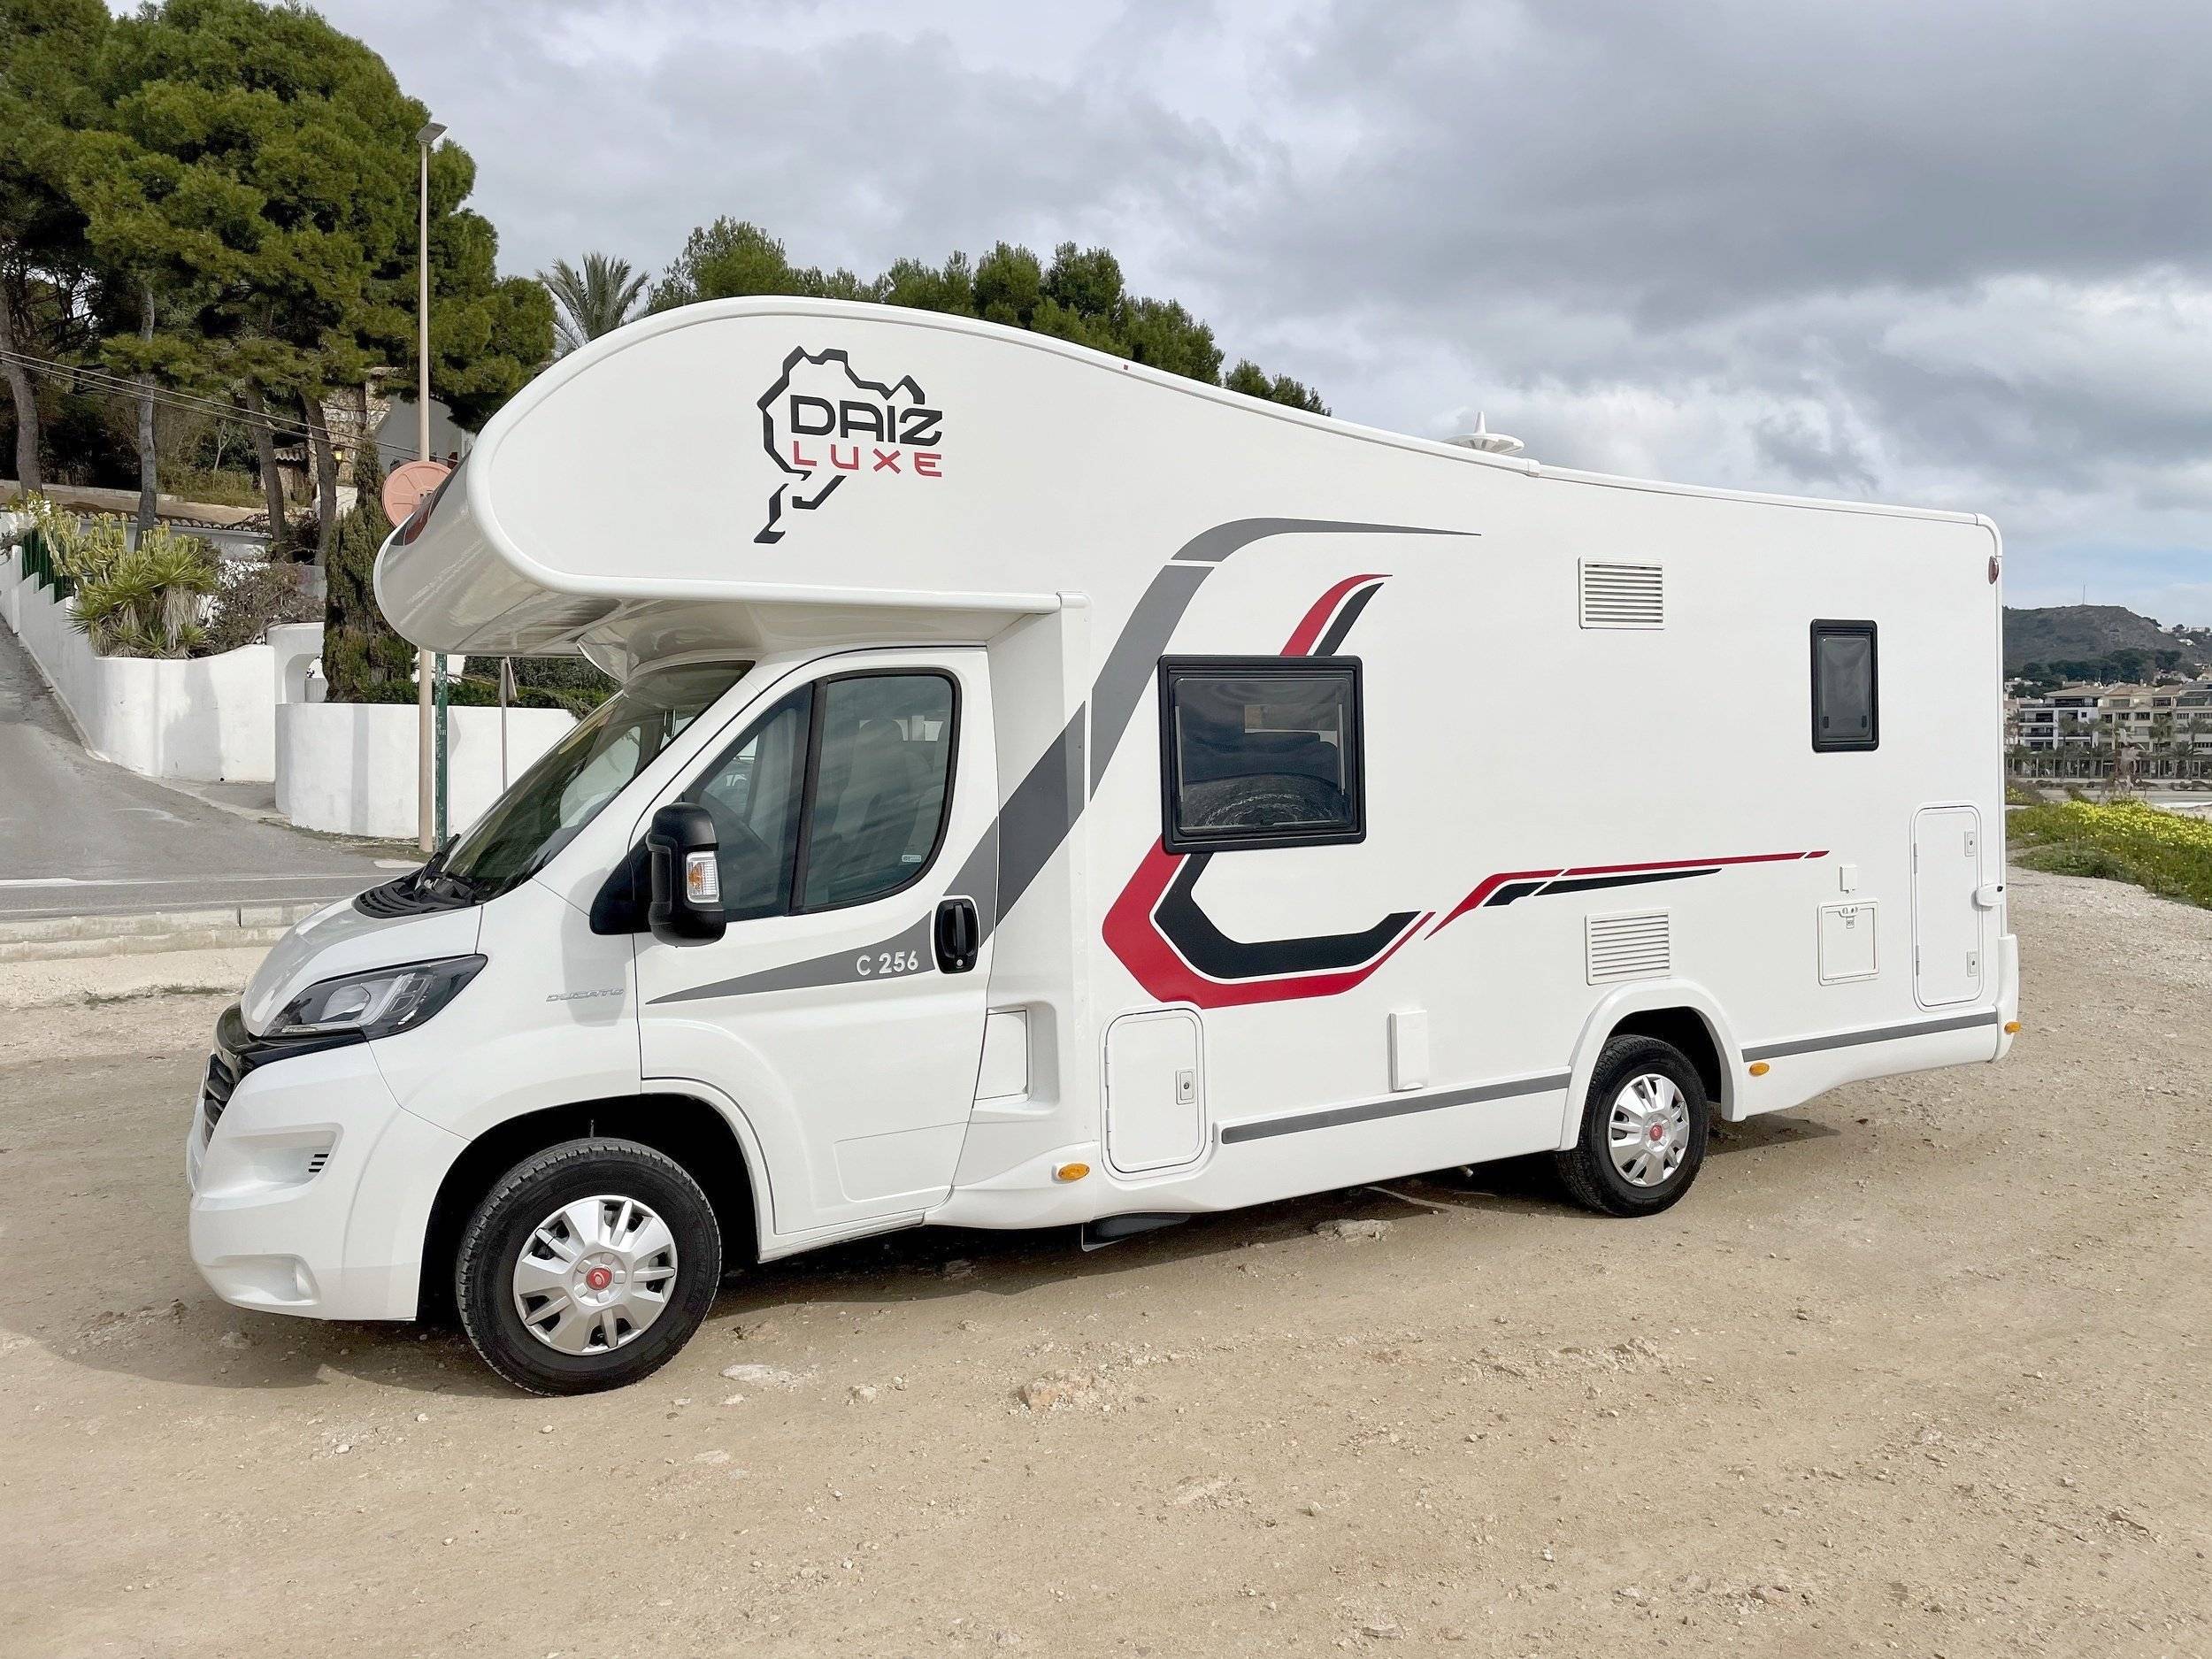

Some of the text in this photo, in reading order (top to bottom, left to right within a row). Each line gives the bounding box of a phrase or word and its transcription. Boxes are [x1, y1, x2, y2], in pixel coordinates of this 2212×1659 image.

[790, 395, 943, 447] DAIZ
[793, 440, 942, 478] LUXE
[856, 949, 918, 976] C 256
